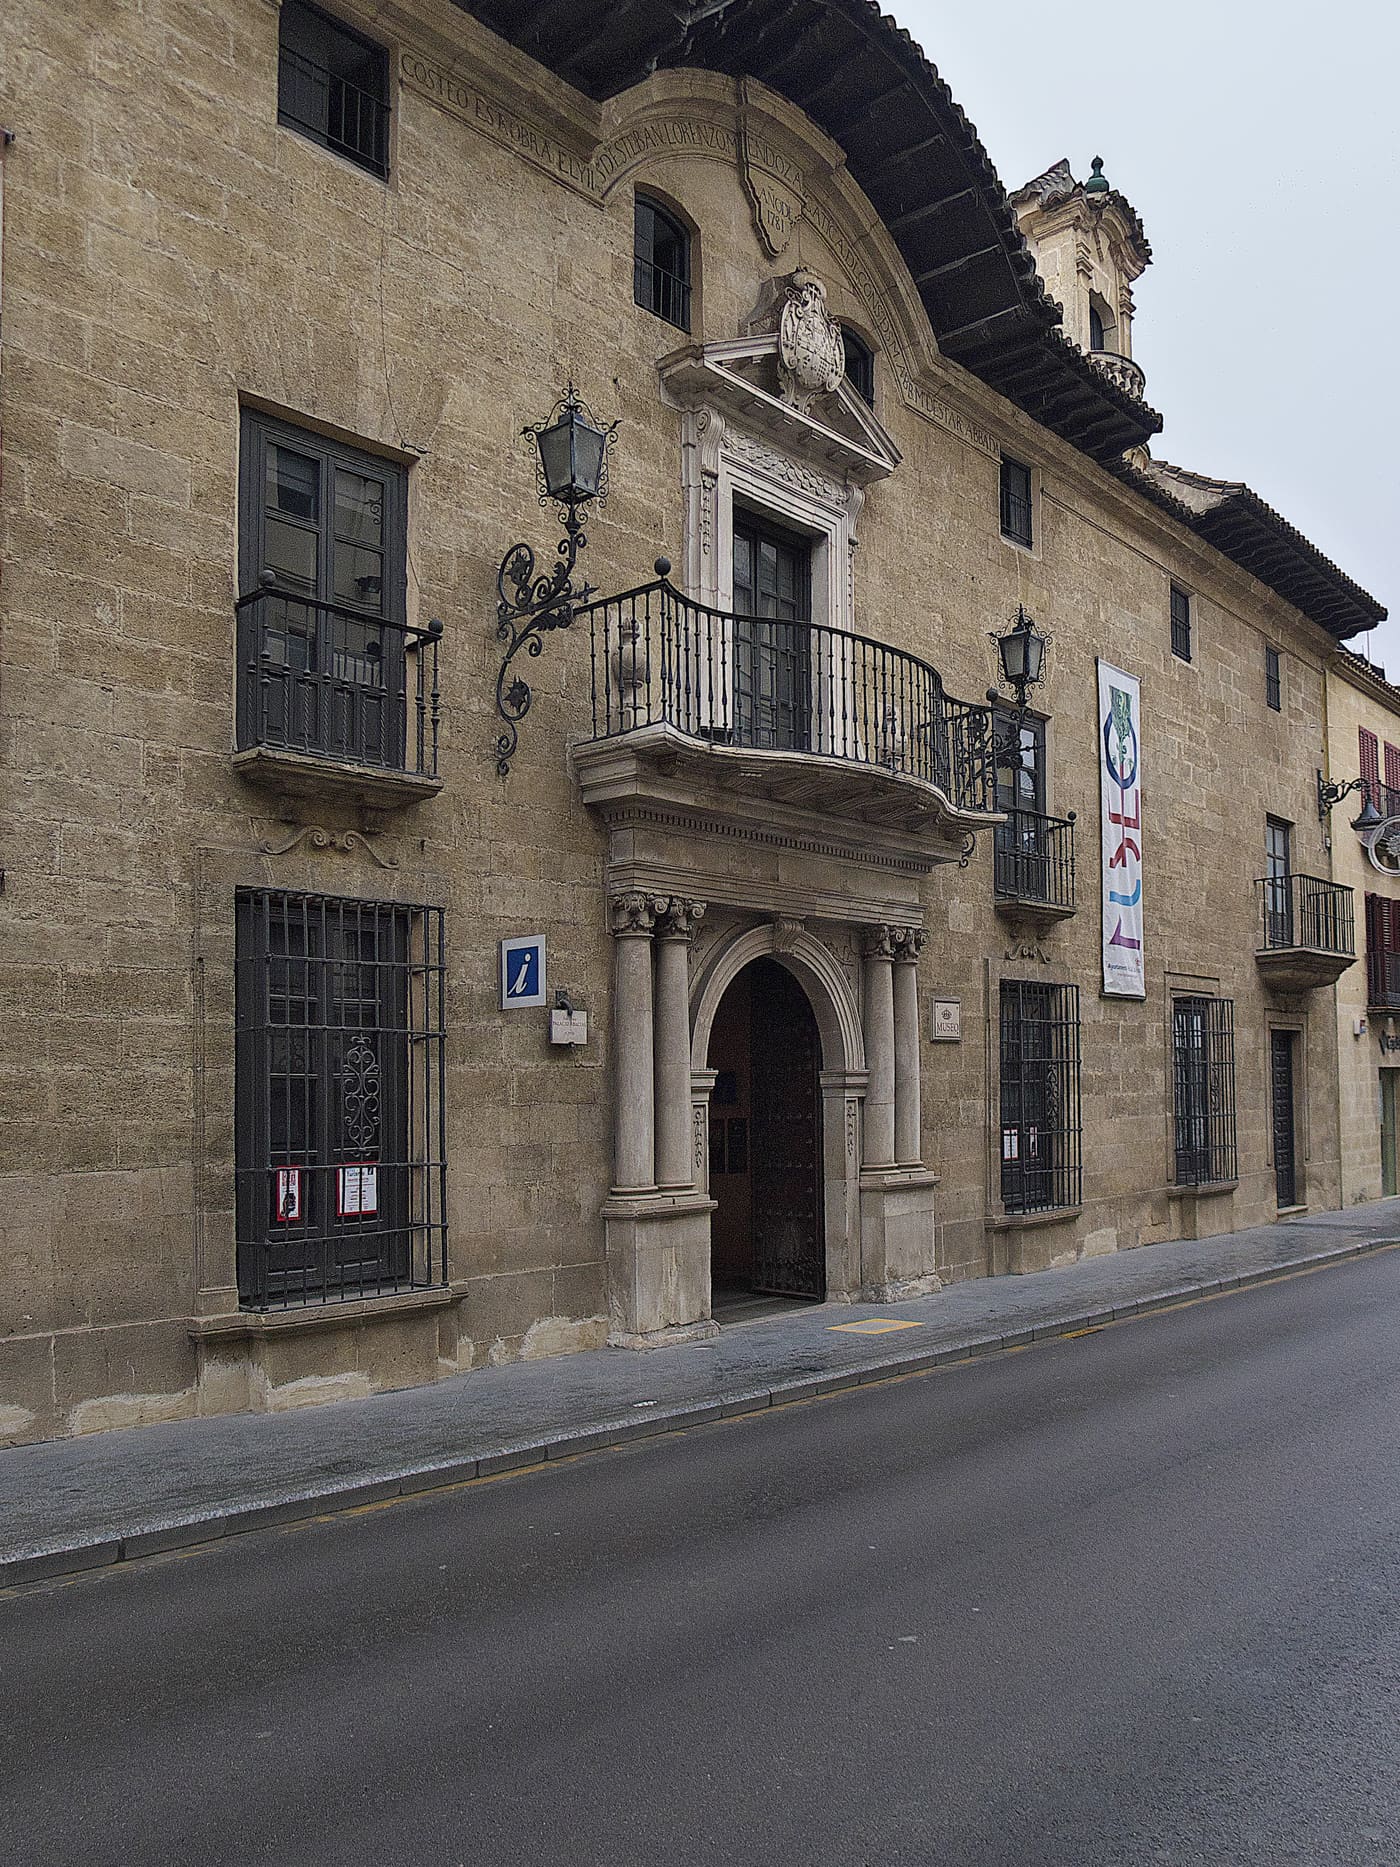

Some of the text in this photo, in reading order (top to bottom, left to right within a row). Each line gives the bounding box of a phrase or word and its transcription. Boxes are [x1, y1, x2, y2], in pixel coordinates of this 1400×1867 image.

[401, 53, 468, 109] COSTEO
[767, 209, 784, 233] 1781
[936, 1022, 960, 1033] MUSEO
